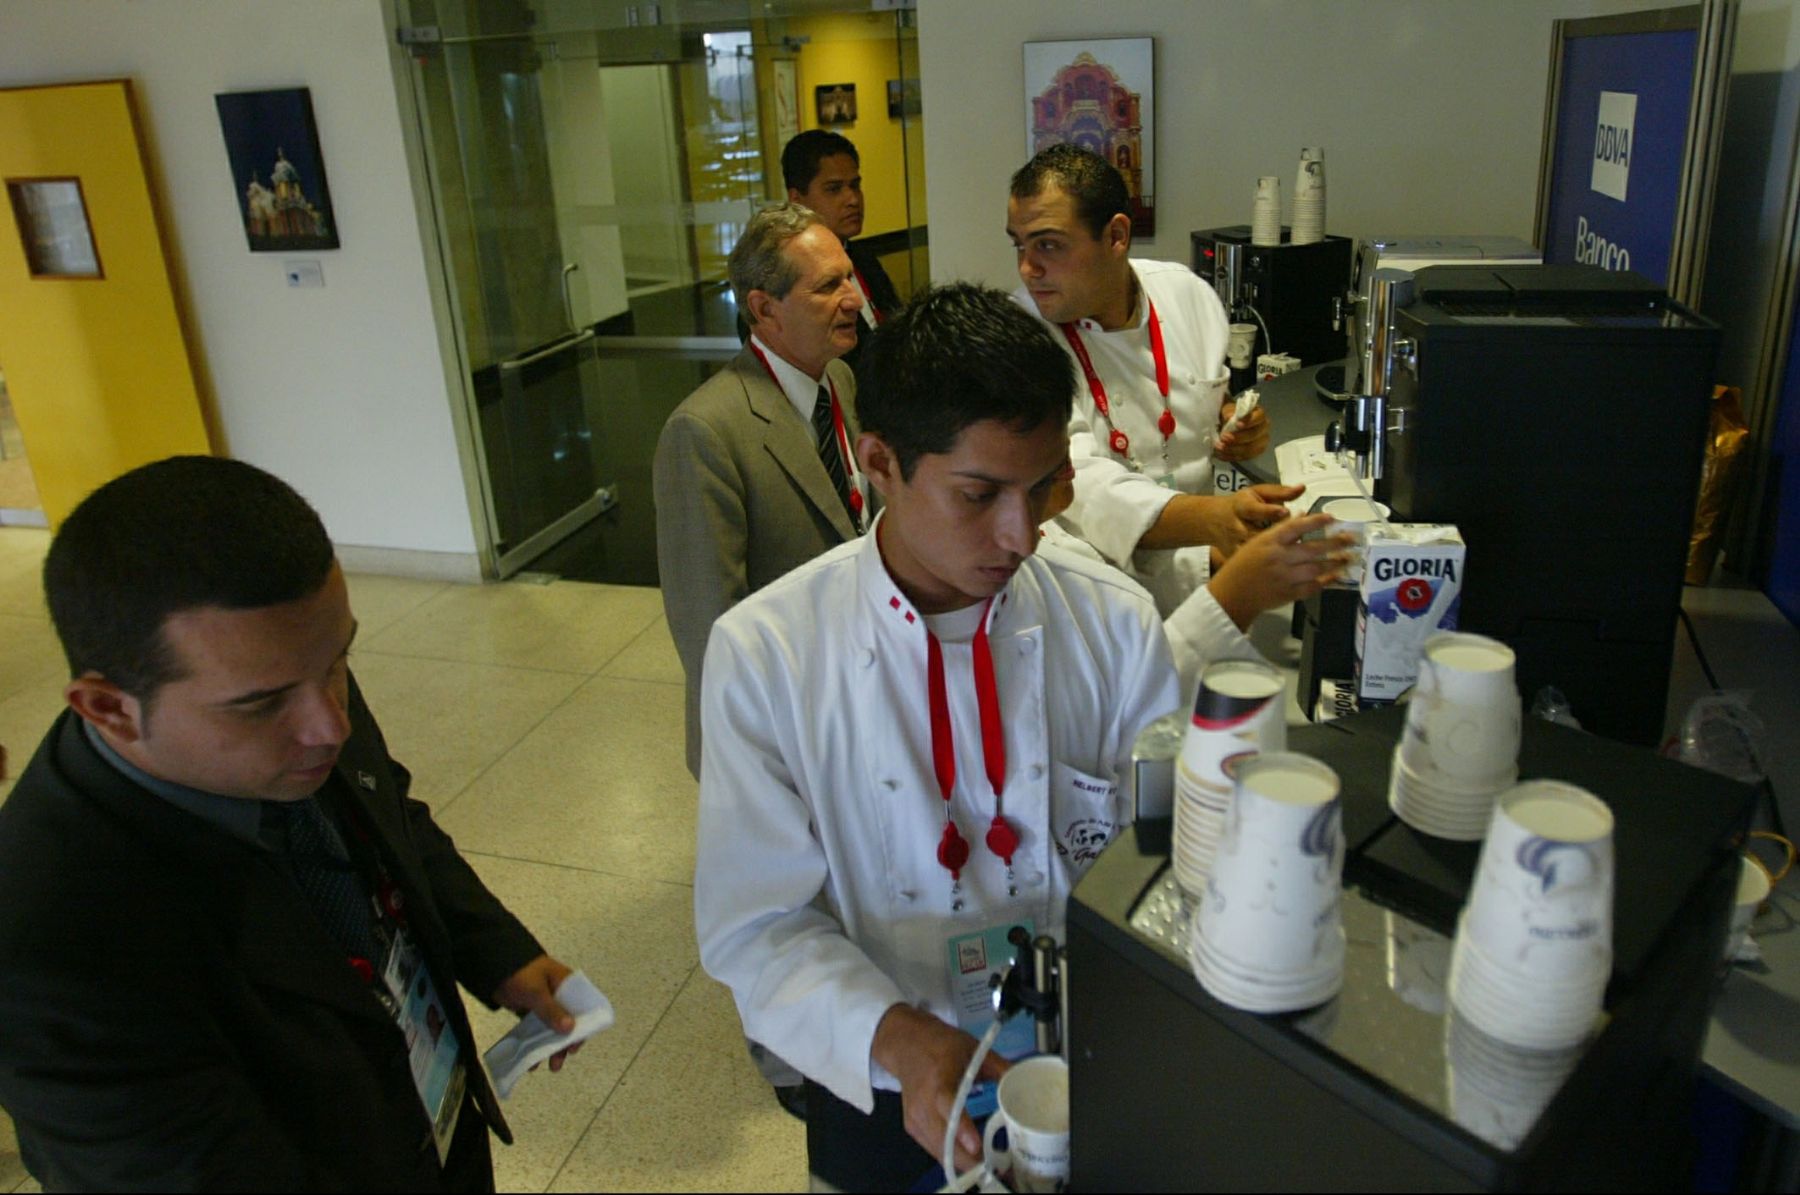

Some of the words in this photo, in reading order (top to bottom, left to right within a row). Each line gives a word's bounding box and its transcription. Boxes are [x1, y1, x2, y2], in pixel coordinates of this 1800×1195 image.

[1596, 124, 1629, 168] BBVA
[1575, 215, 1630, 272] Banco
[1374, 557, 1456, 583] GLORIA
